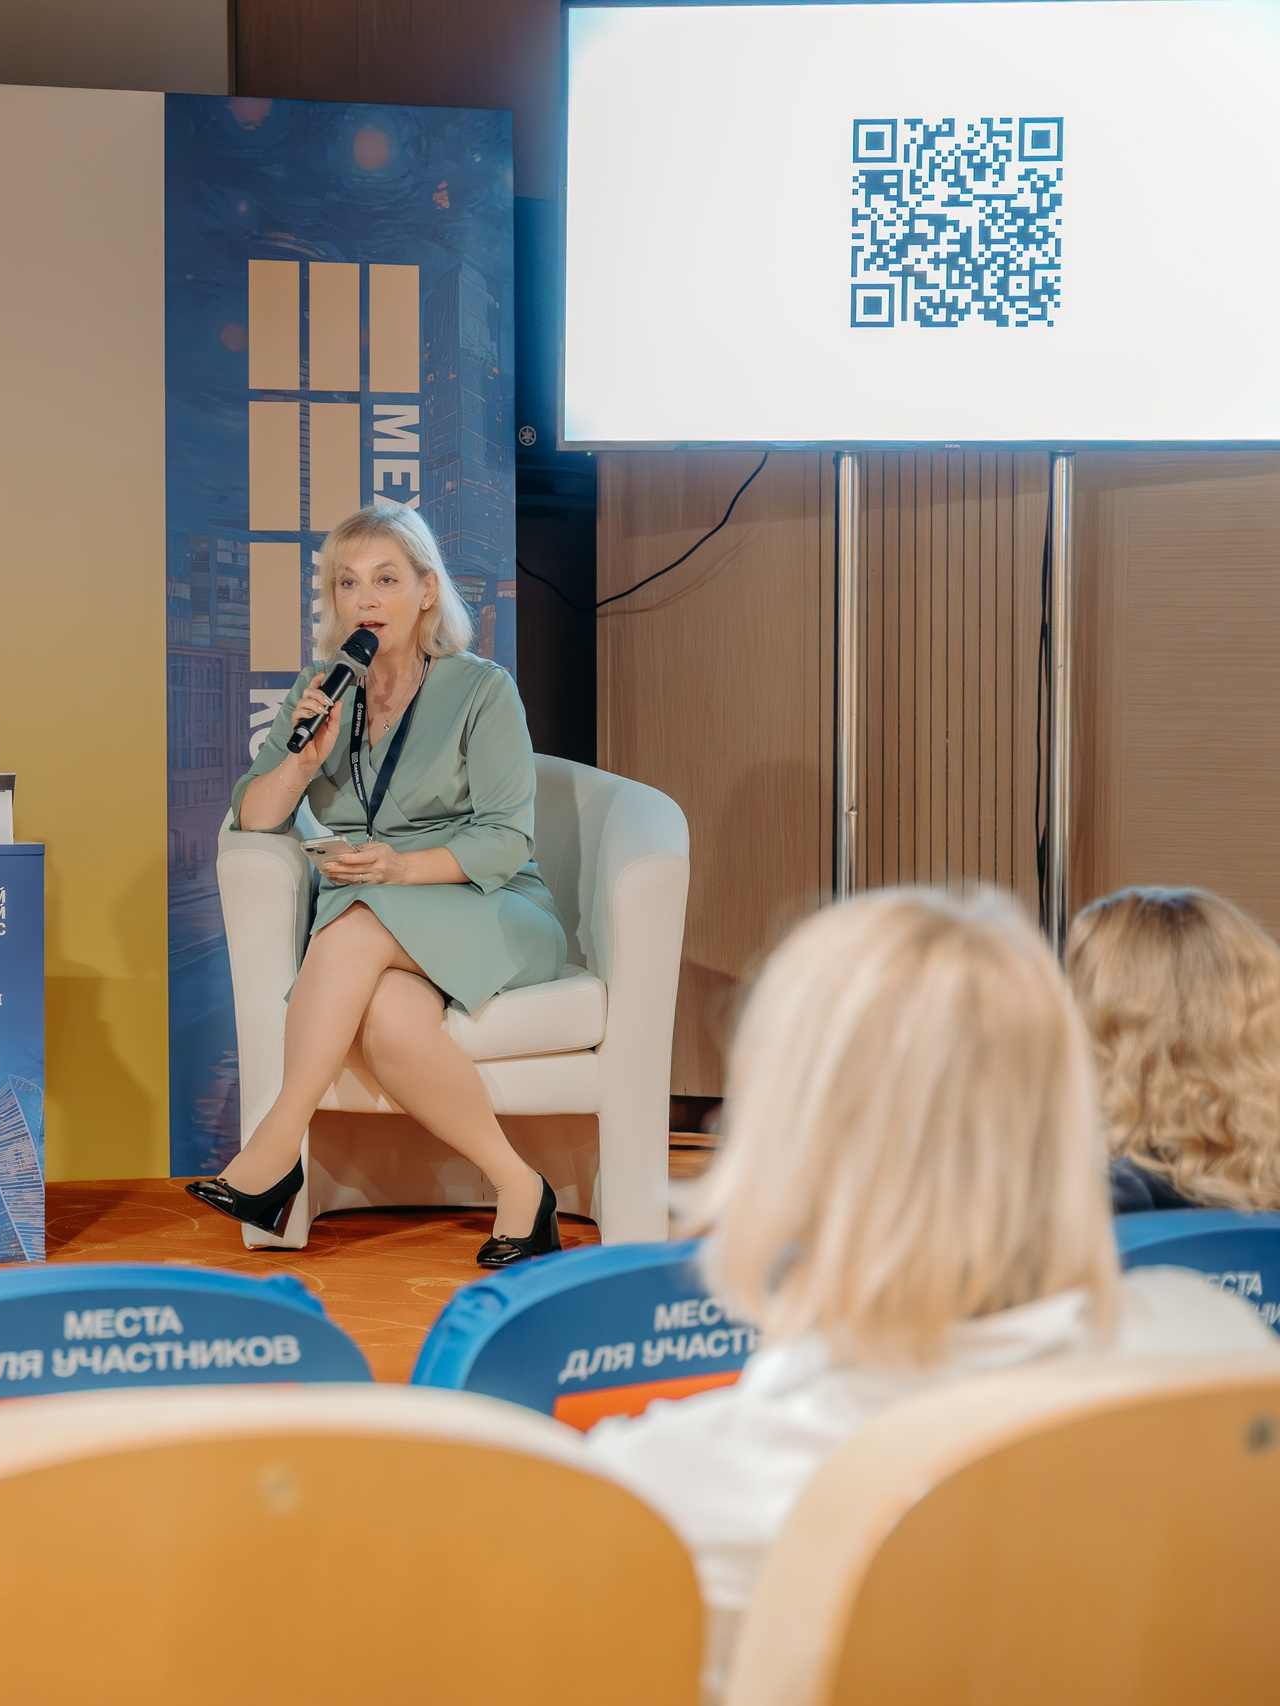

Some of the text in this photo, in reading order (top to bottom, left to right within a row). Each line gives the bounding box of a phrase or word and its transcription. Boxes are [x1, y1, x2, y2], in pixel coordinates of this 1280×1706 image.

[64, 1305, 184, 1341] МЕСТА
[654, 1297, 724, 1332] МЕС
[51, 1334, 301, 1378] УЧАСТНИКОВ
[557, 1327, 764, 1385] ДЛЯ УЧАСТН
